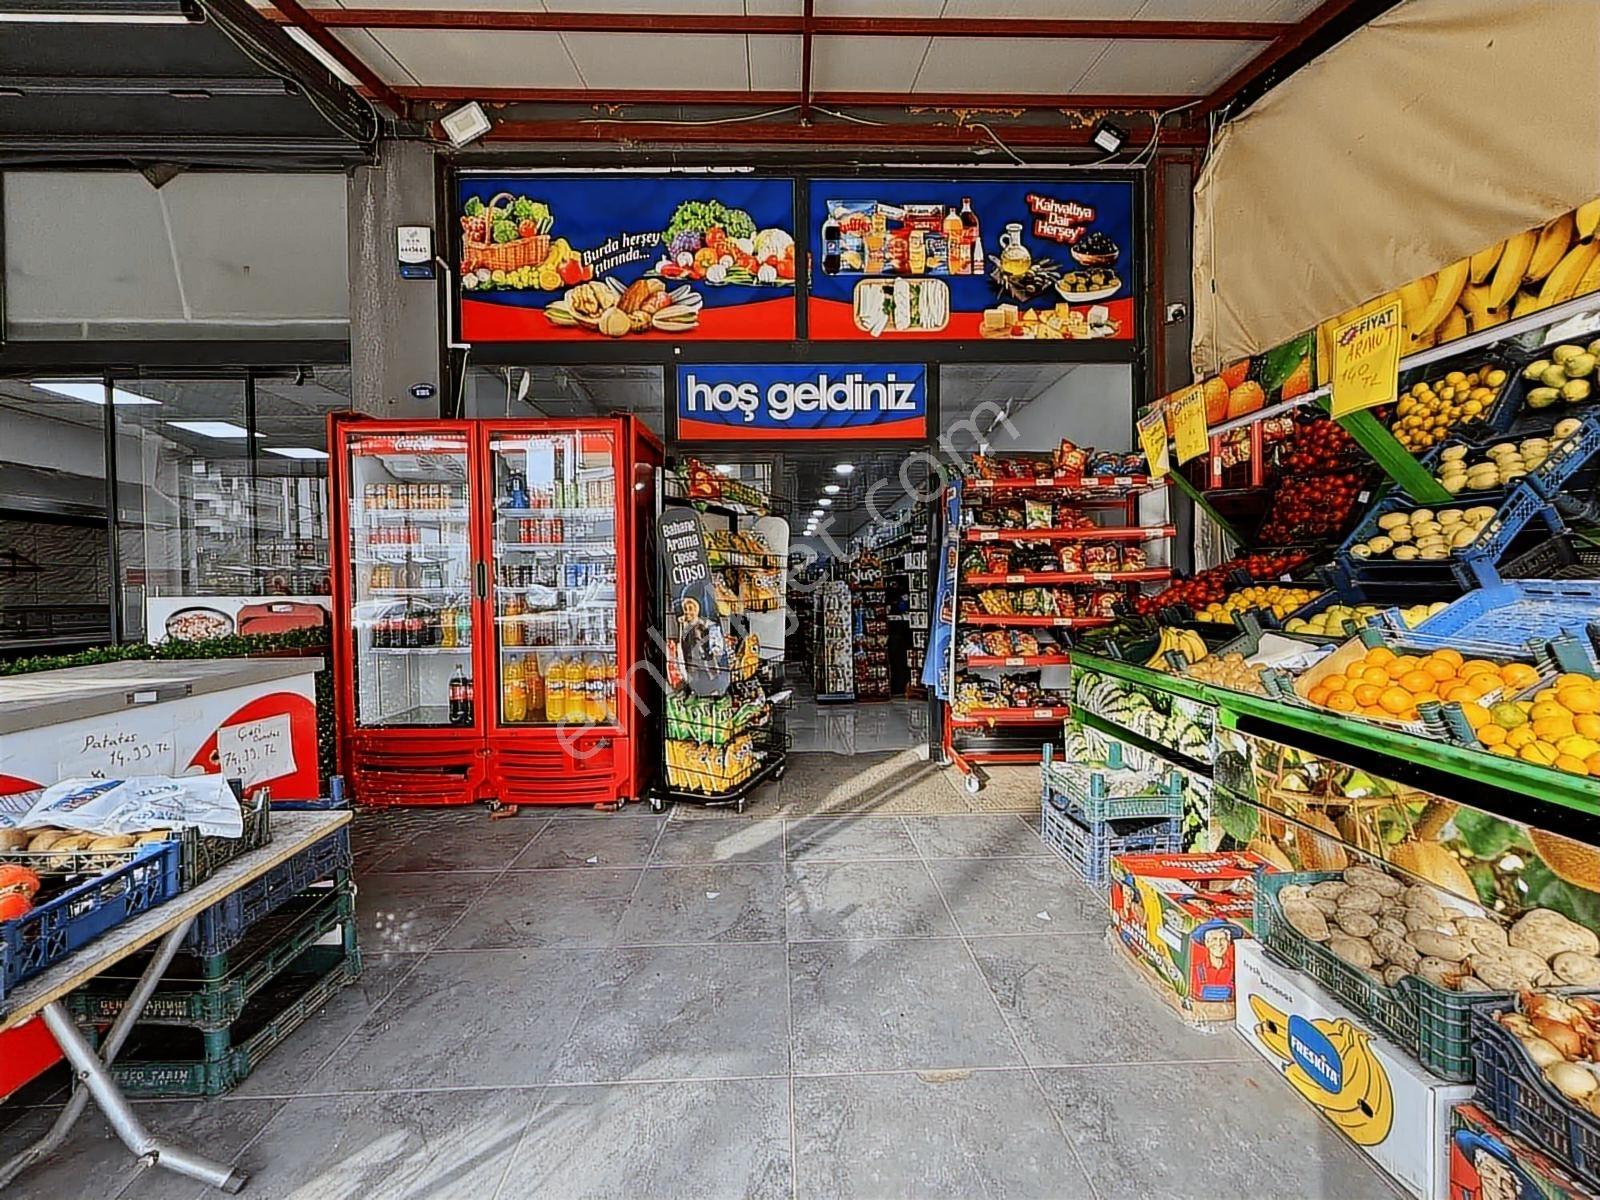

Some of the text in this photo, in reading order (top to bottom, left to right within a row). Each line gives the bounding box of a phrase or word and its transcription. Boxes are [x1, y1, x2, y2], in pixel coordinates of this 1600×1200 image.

[1049, 211, 1070, 227] Dair
[583, 233, 660, 265] Burda herşey
[687, 374, 916, 422] hoş geldiniz
[662, 520, 696, 537] Bahane
[666, 533, 700, 553] Arama
